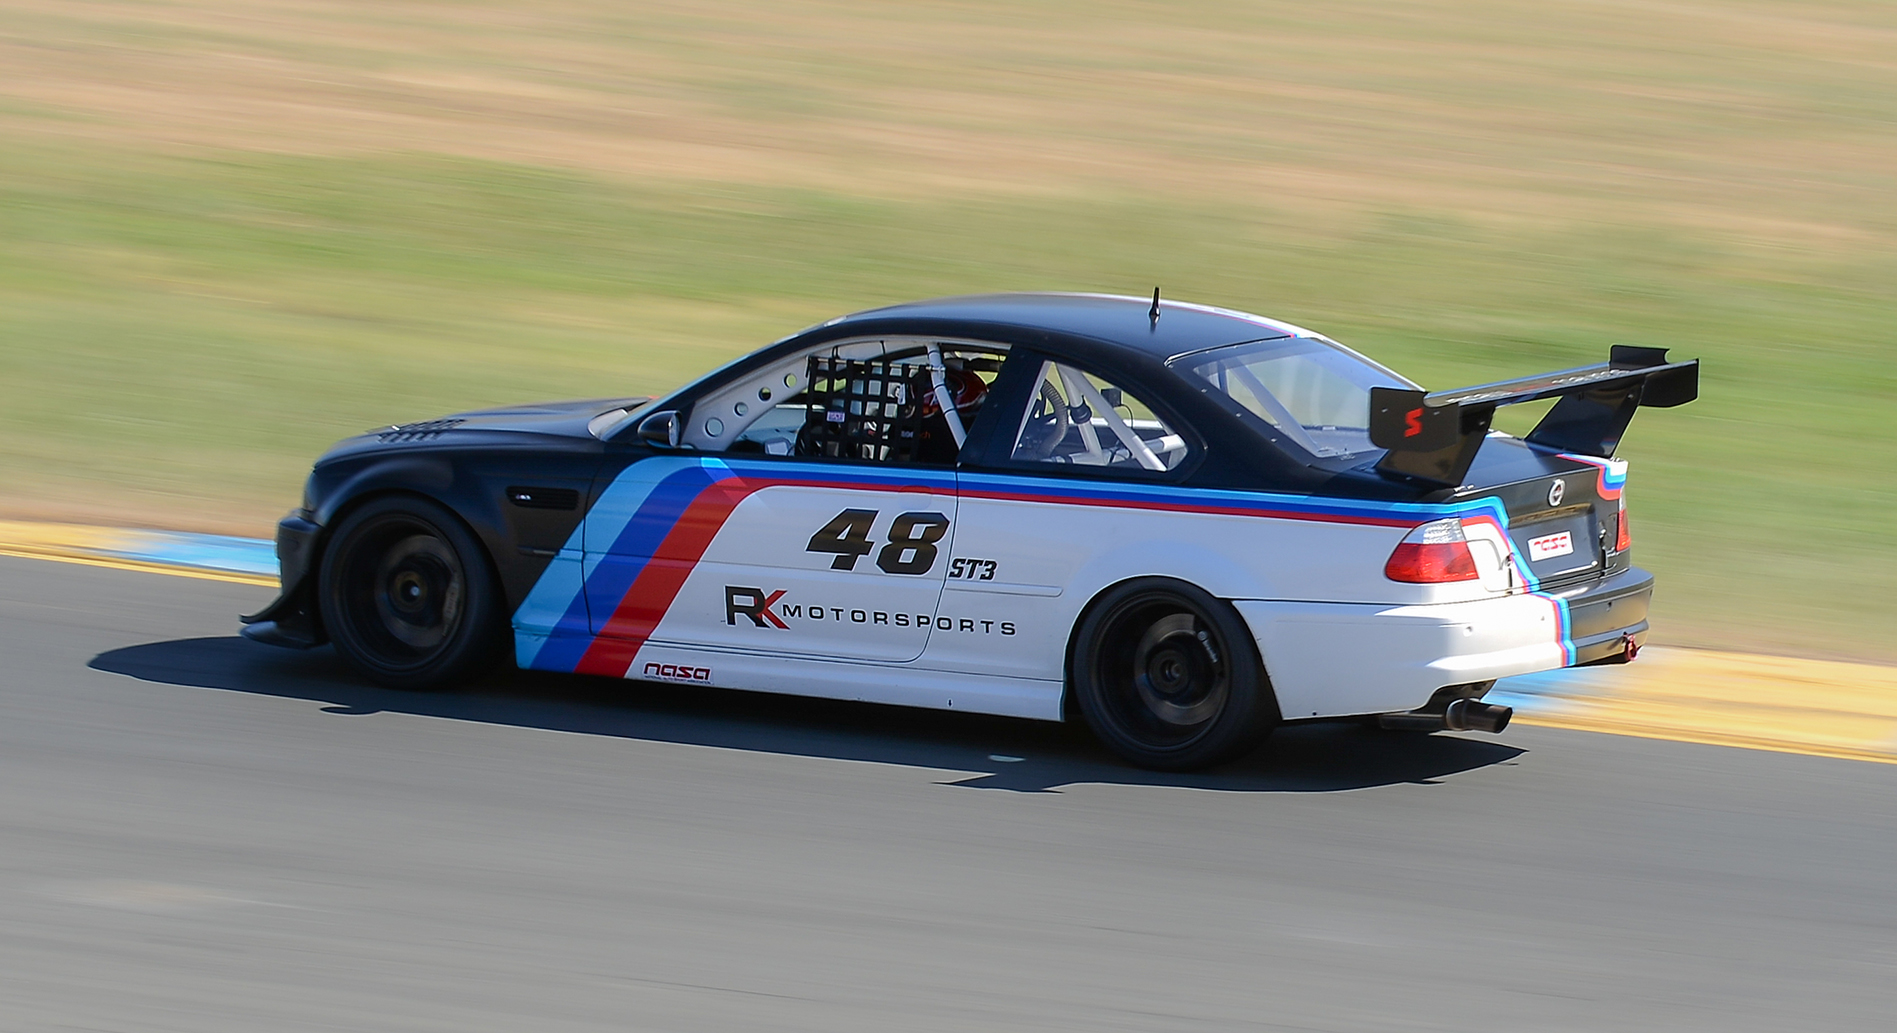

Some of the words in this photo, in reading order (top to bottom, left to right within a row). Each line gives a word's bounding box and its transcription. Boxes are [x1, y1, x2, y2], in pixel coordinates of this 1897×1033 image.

[806, 508, 950, 575] 48
[949, 558, 998, 580] ST3
[725, 585, 790, 630] RK
[782, 604, 1016, 635] MOTORSPORTS
